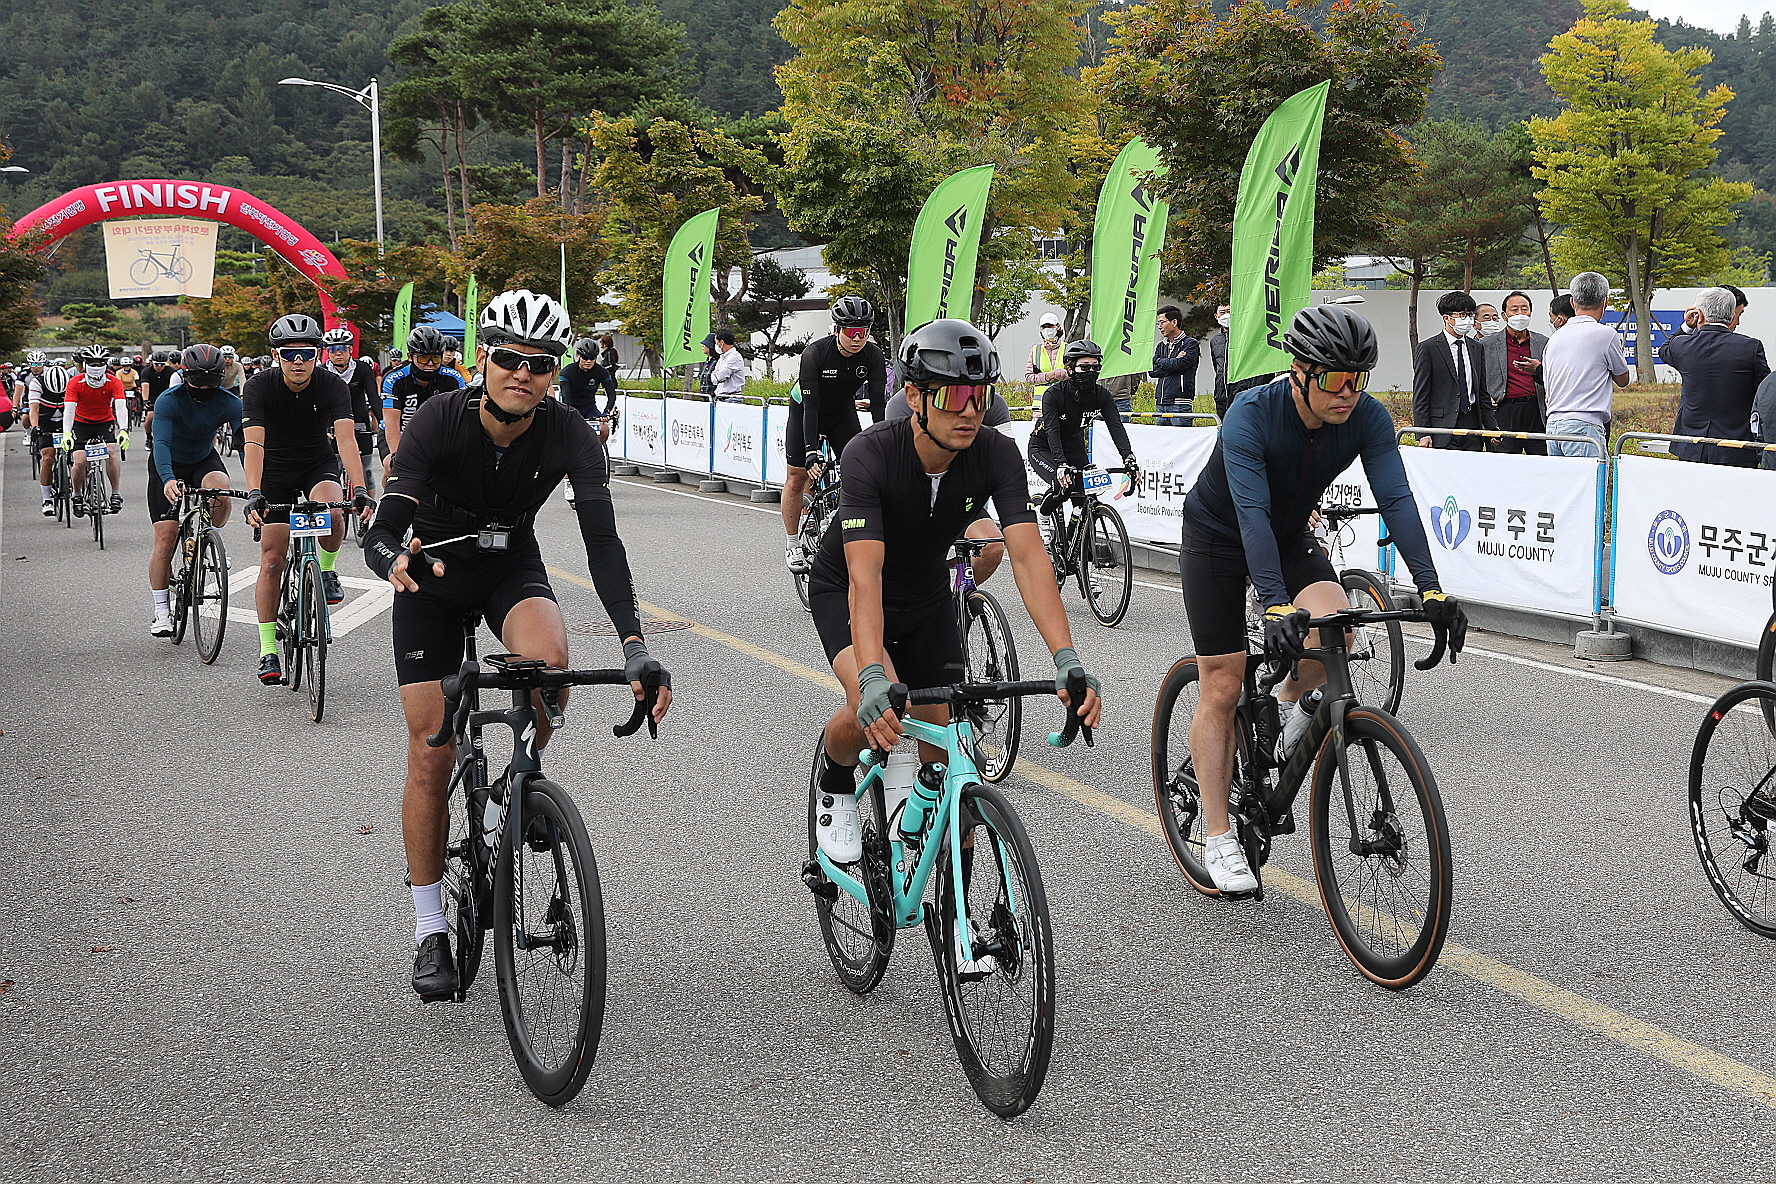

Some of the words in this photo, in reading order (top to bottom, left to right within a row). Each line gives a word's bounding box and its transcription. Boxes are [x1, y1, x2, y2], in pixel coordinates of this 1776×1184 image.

[94, 183, 232, 214] FINISH
[88, 448, 106, 457] 228
[1087, 475, 1109, 487] 196
[1477, 506, 1555, 544] 무주군
[1477, 540, 1505, 557] MUJU
[1508, 544, 1555, 563] COUNTY
[1698, 564, 1722, 579] MUJU
[1724, 568, 1761, 585] COUNTY
[513, 849, 523, 932] SPECIALIZED
